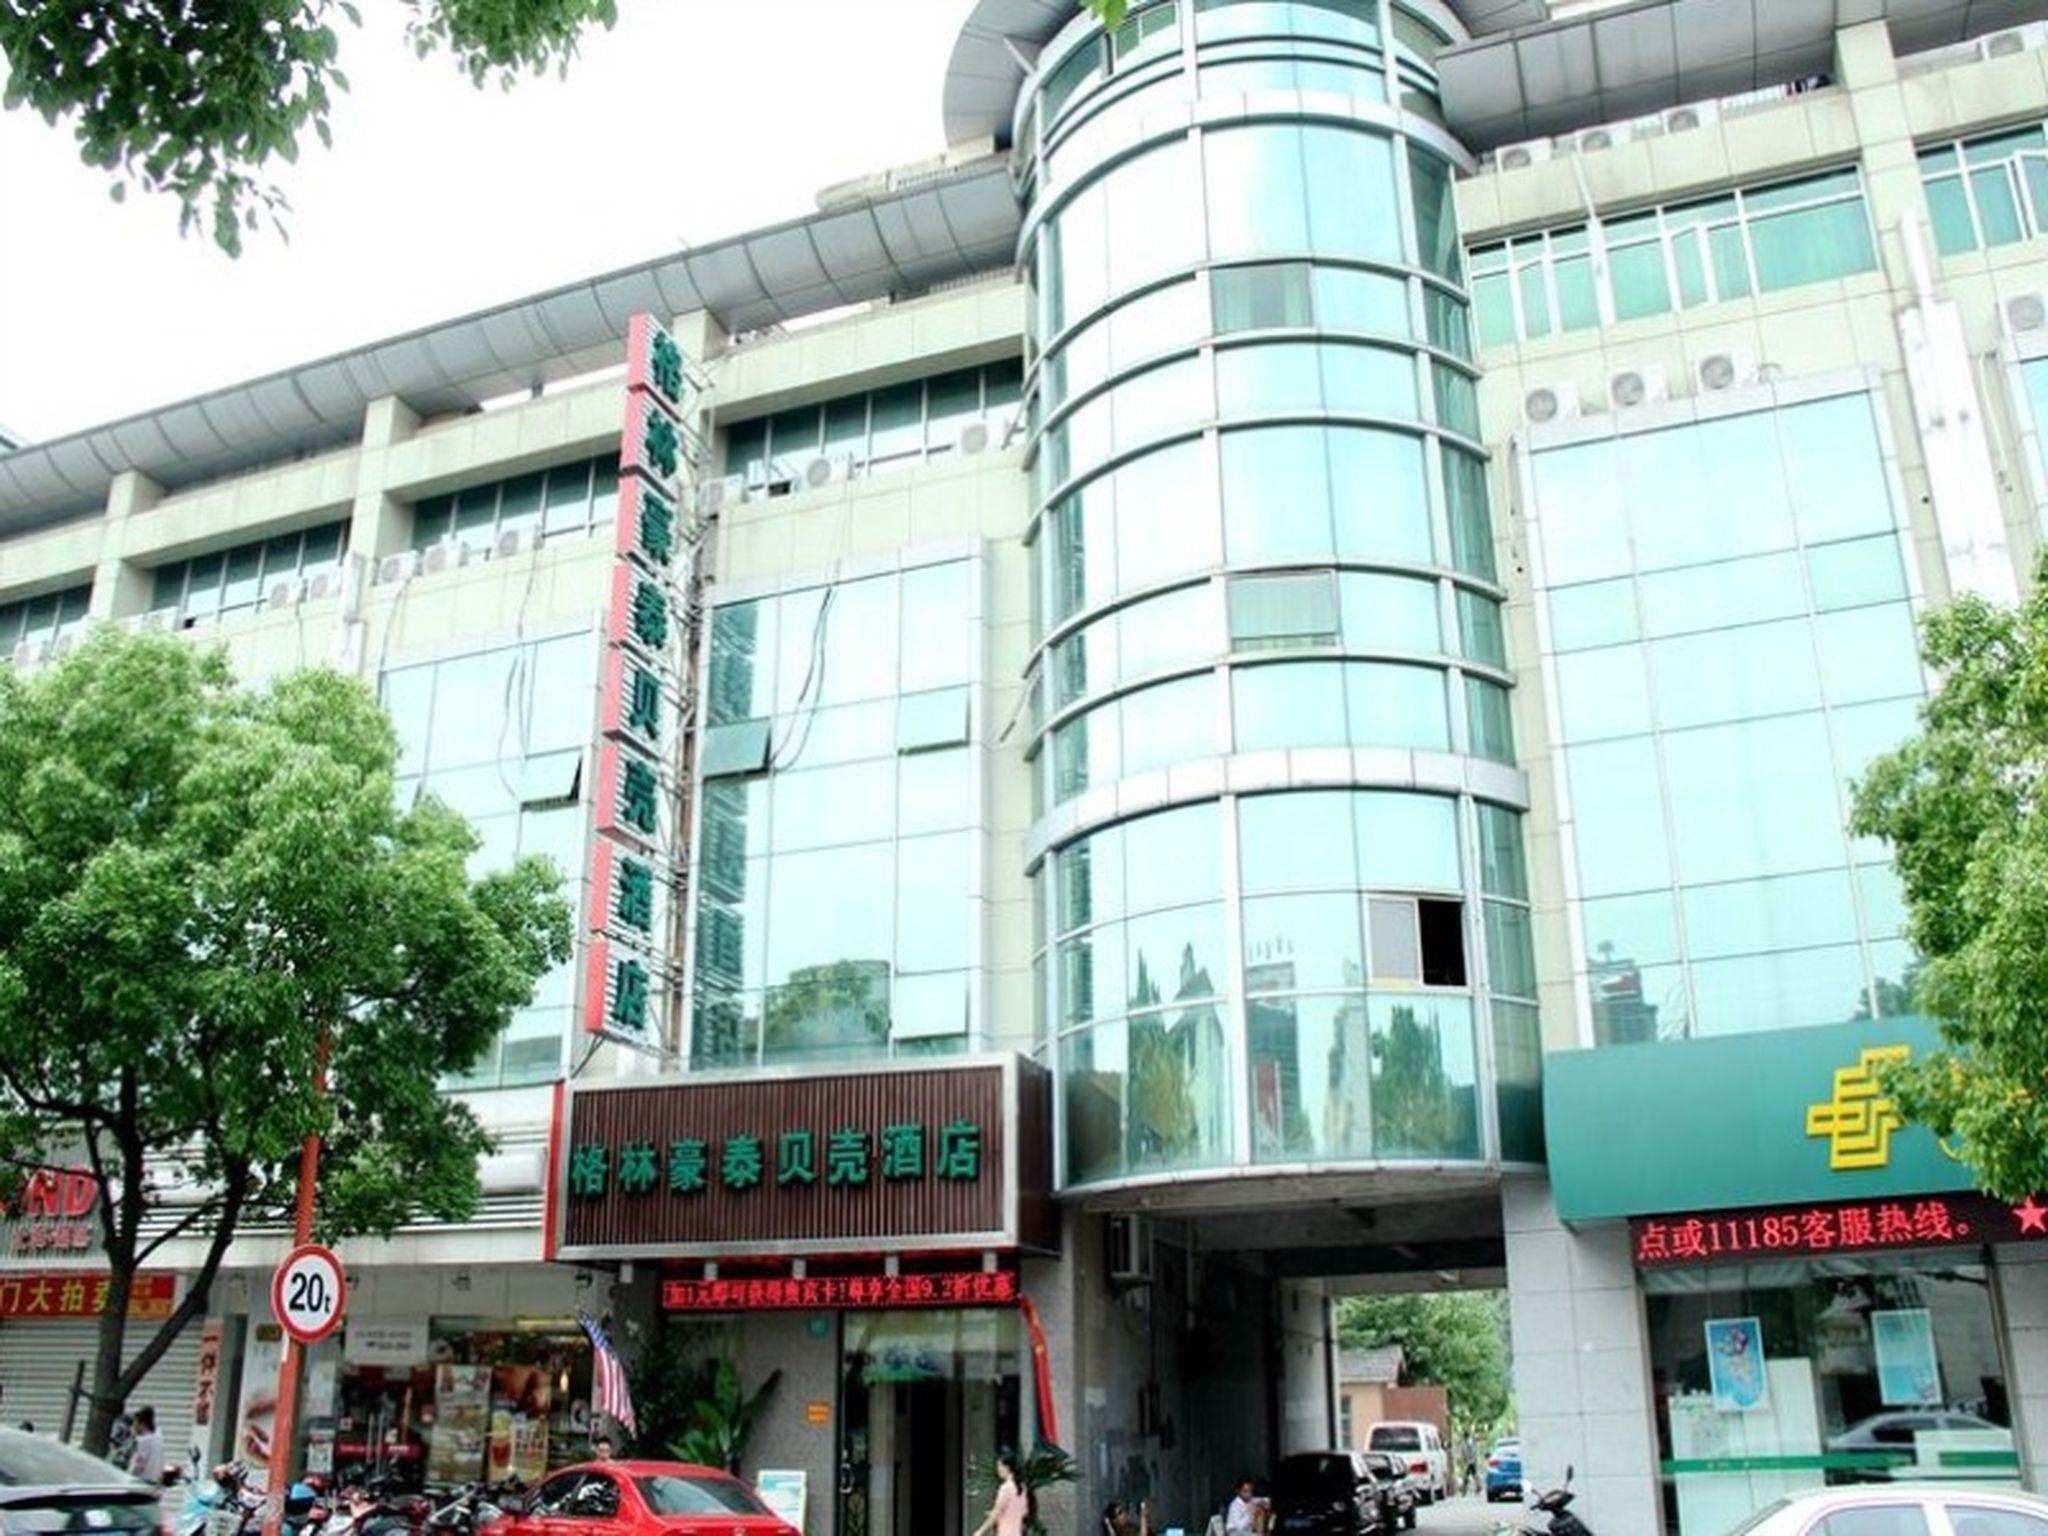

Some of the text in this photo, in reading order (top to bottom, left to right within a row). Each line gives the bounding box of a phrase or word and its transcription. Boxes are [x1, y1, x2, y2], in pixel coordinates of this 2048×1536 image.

[612, 330, 683, 1031] 格林豪泰贝壳酒店
[571, 1118, 982, 1196] 格林豪泰贝壳酒店
[1637, 1201, 1970, 1260] 点或11185客服热线。
